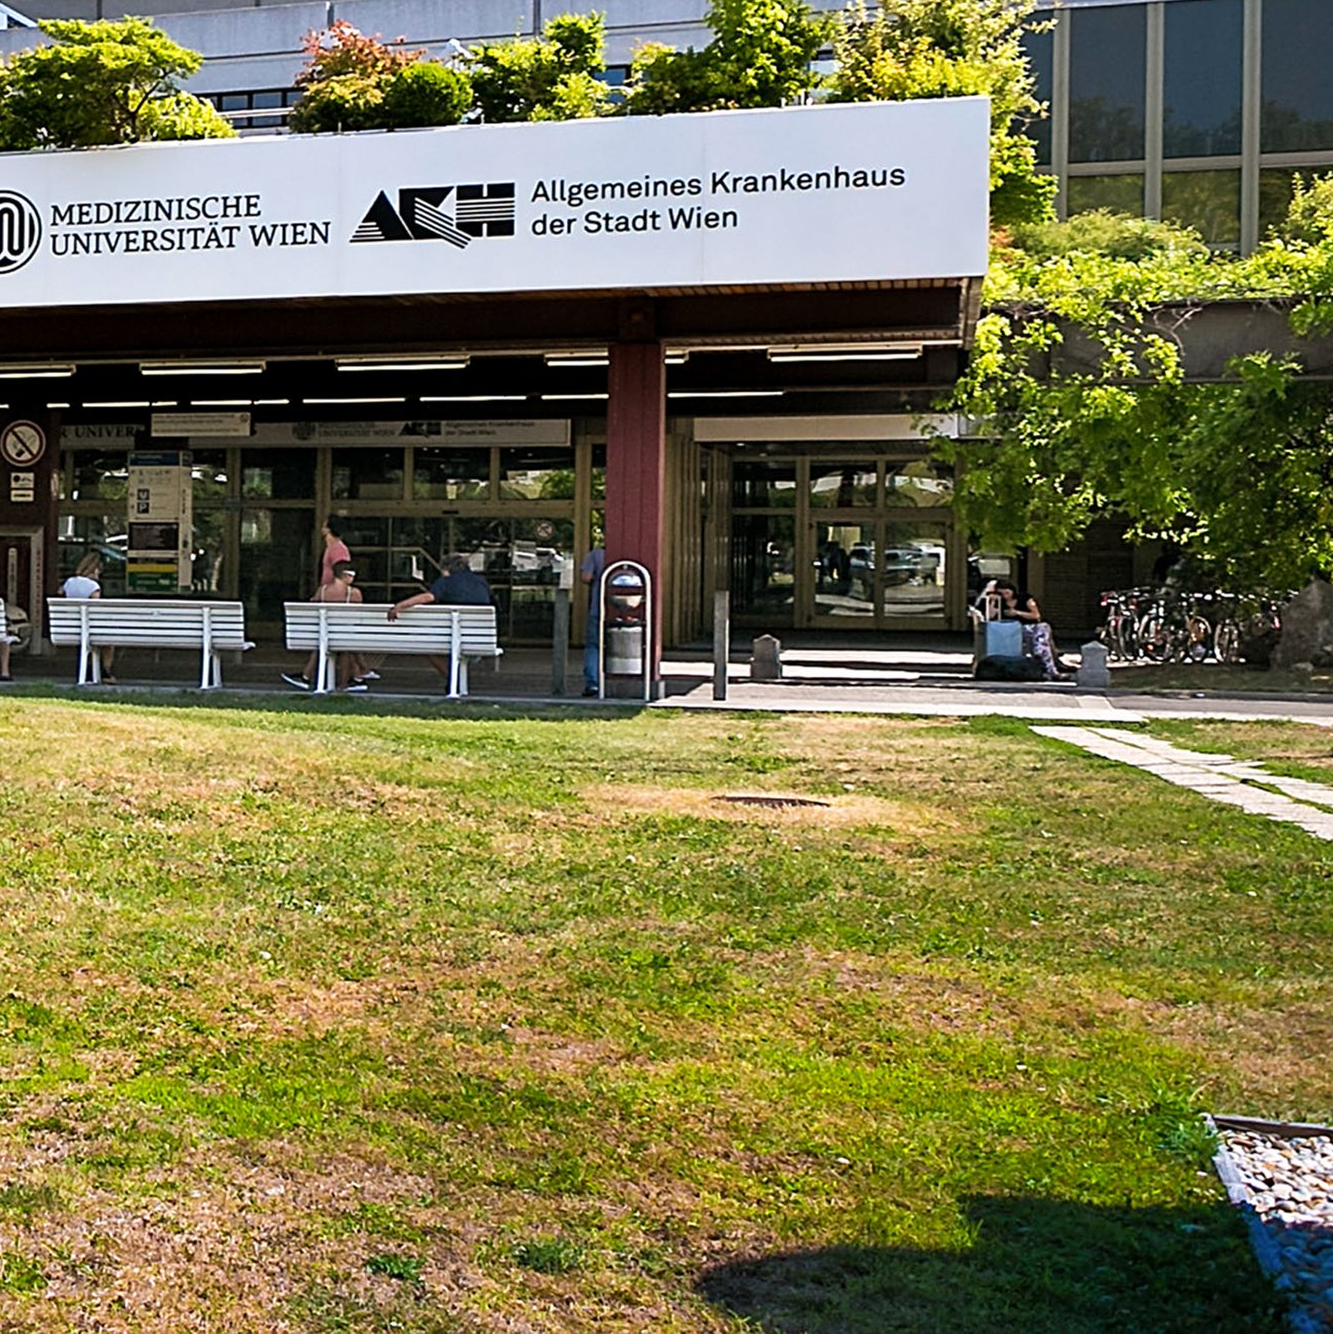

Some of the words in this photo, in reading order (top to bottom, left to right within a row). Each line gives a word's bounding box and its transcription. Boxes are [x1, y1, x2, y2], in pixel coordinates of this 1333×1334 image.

[531, 175, 702, 208] Allgemeines
[711, 165, 905, 195] Krankenhaus
[50, 194, 262, 227] MEDIZINISCHE
[531, 213, 577, 236] der
[583, 208, 661, 234] Stadt
[668, 206, 738, 230] Wien
[50, 221, 241, 256] UNIVERSITÄT
[248, 221, 331, 247] WIEN
